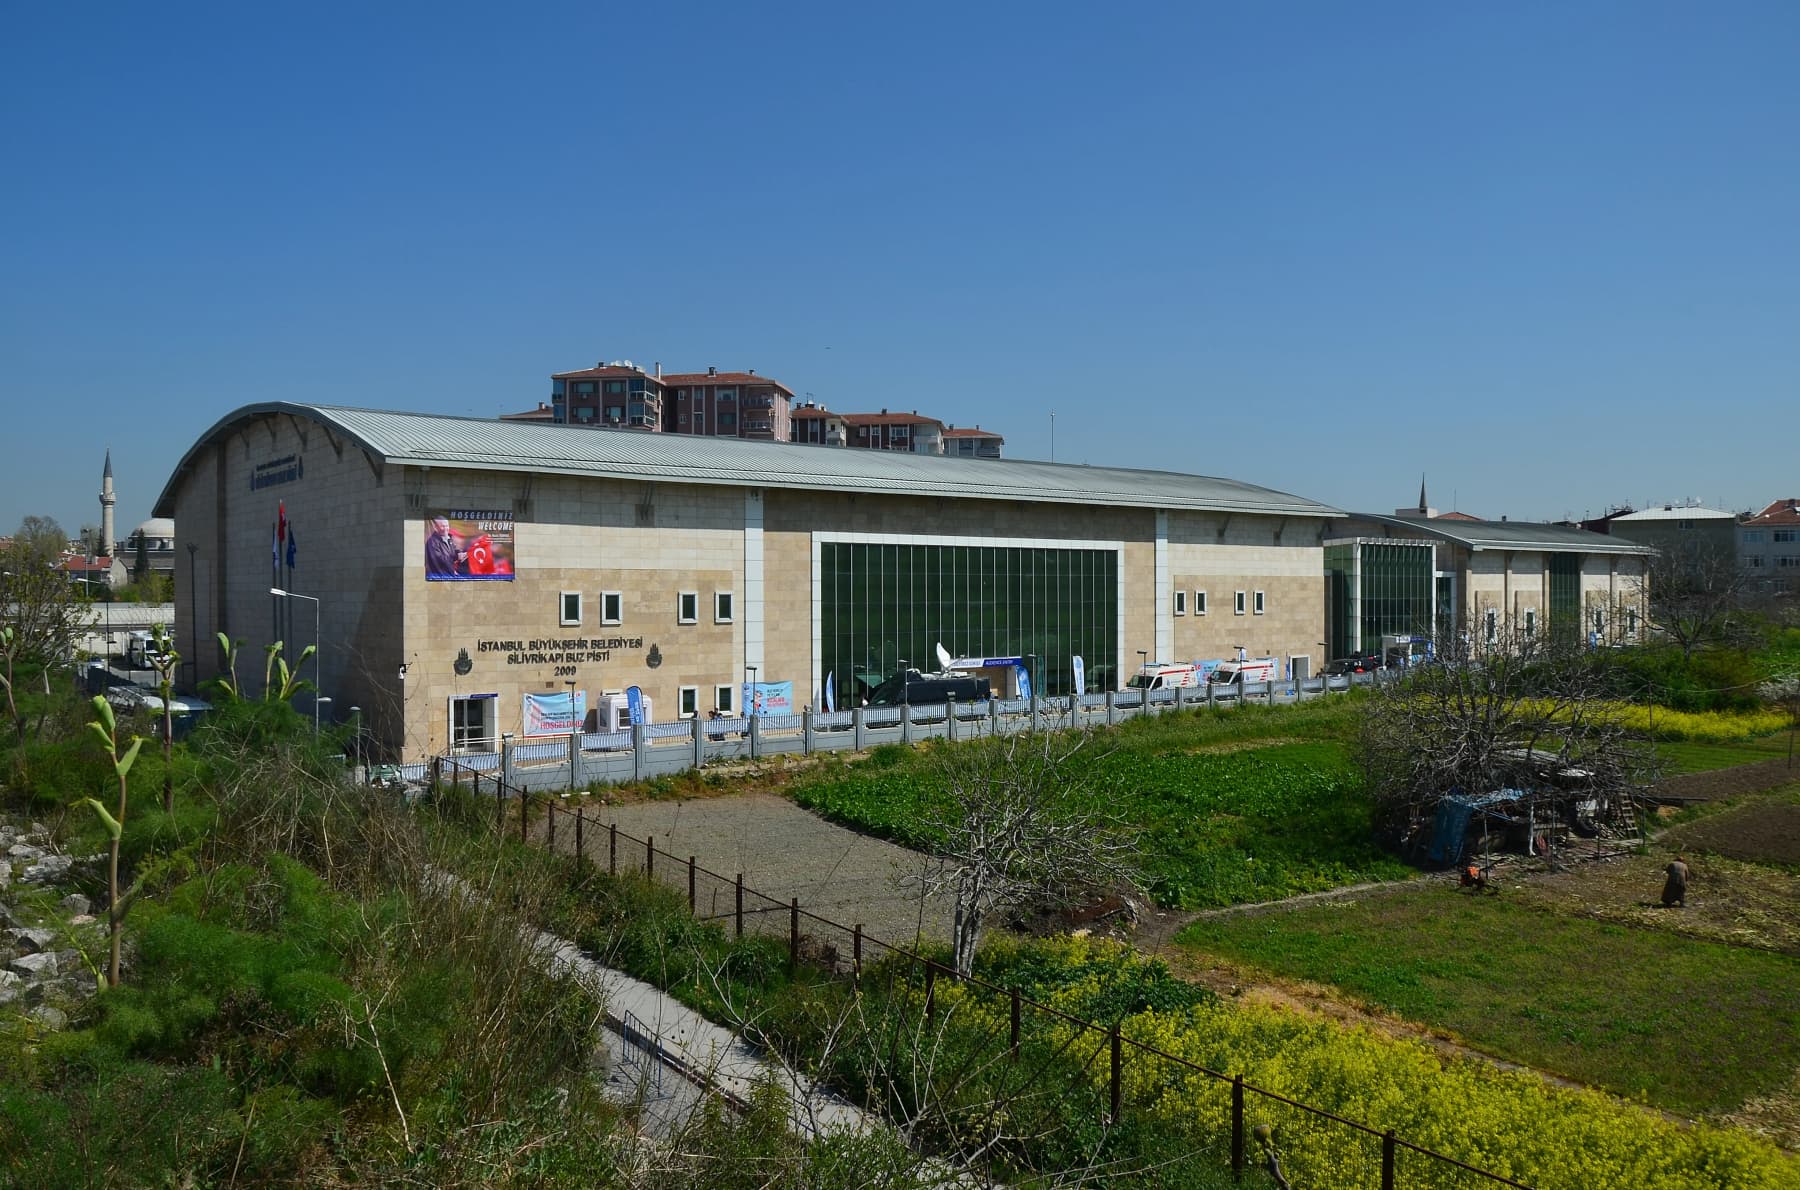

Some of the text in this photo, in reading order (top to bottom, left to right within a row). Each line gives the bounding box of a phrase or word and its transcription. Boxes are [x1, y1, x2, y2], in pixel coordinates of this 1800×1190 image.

[478, 520, 513, 531] WELCOME
[477, 636, 643, 653] İSTANBUL BÜYÜKŞEHİR BELEDİYESİ
[565, 652, 585, 663] BUZ
[586, 650, 610, 662] PİSTİ
[553, 665, 577, 677] 2009
